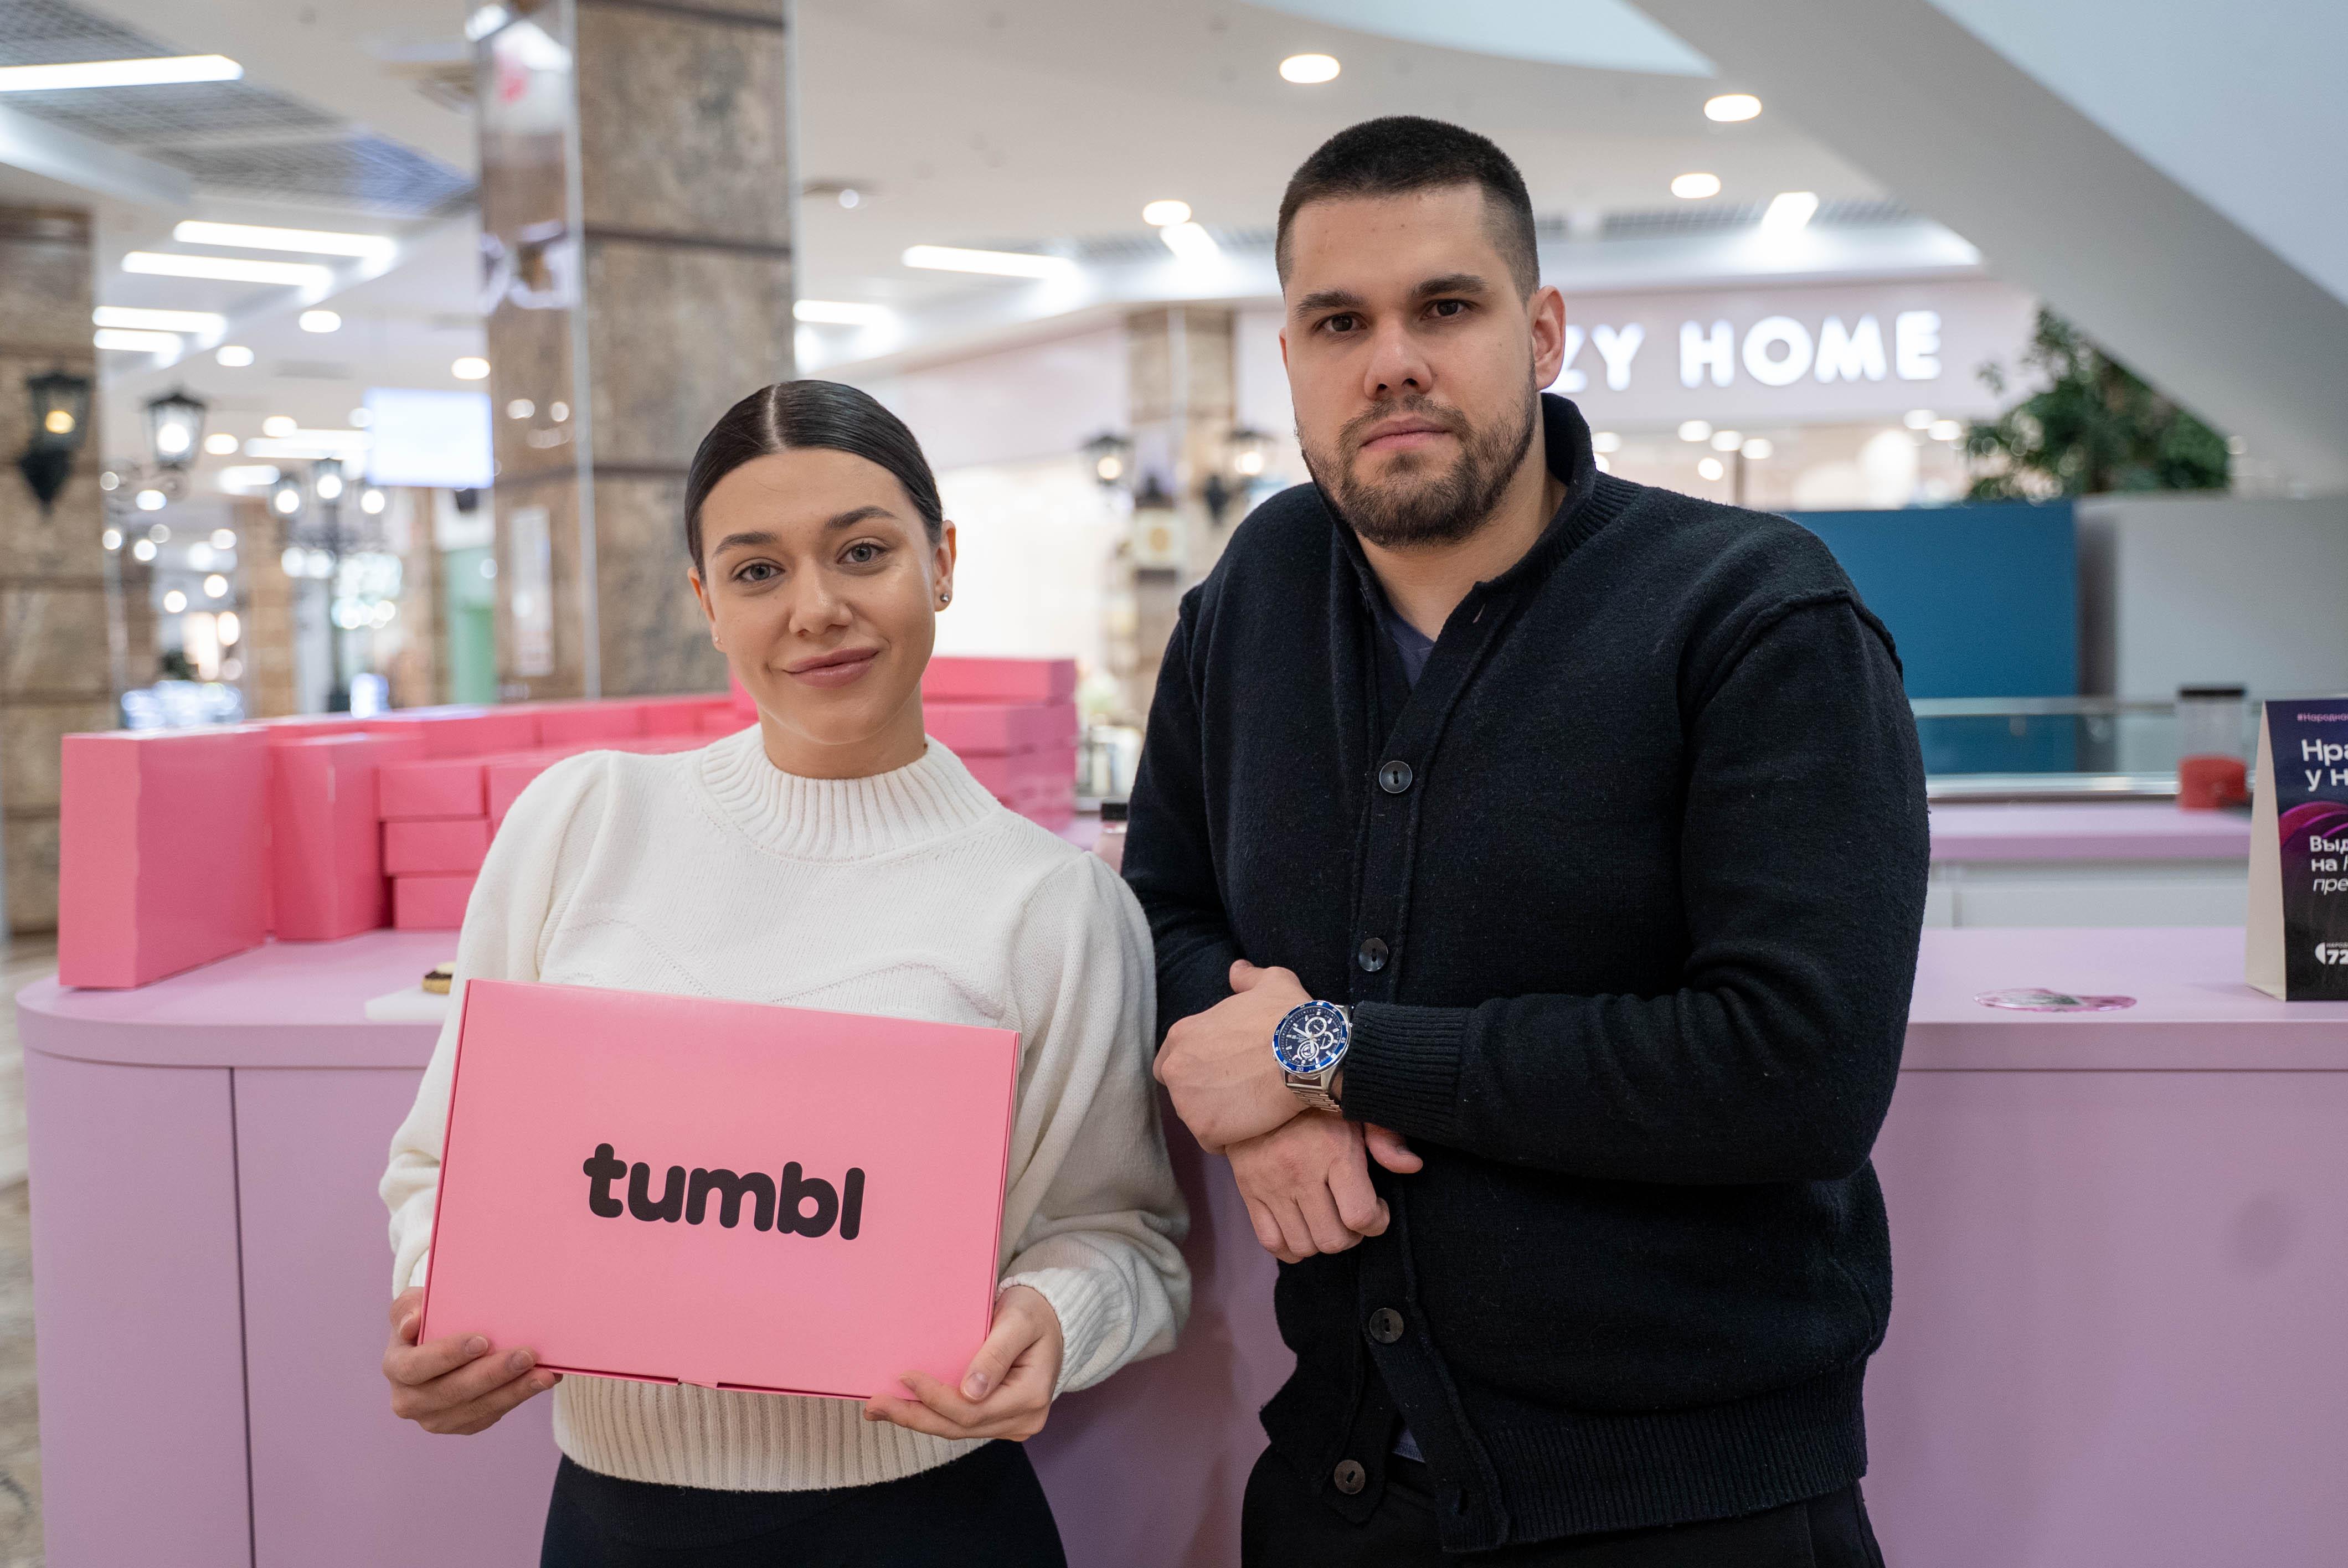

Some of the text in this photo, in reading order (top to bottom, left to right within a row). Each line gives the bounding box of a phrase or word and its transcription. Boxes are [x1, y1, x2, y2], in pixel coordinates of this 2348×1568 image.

[1680, 311, 1941, 388] HOME
[2305, 769, 2322, 792] у
[2311, 858, 2337, 872] на
[2313, 878, 2348, 896] пре
[2326, 949, 2348, 965] 72
[583, 1143, 865, 1240] tumbl
